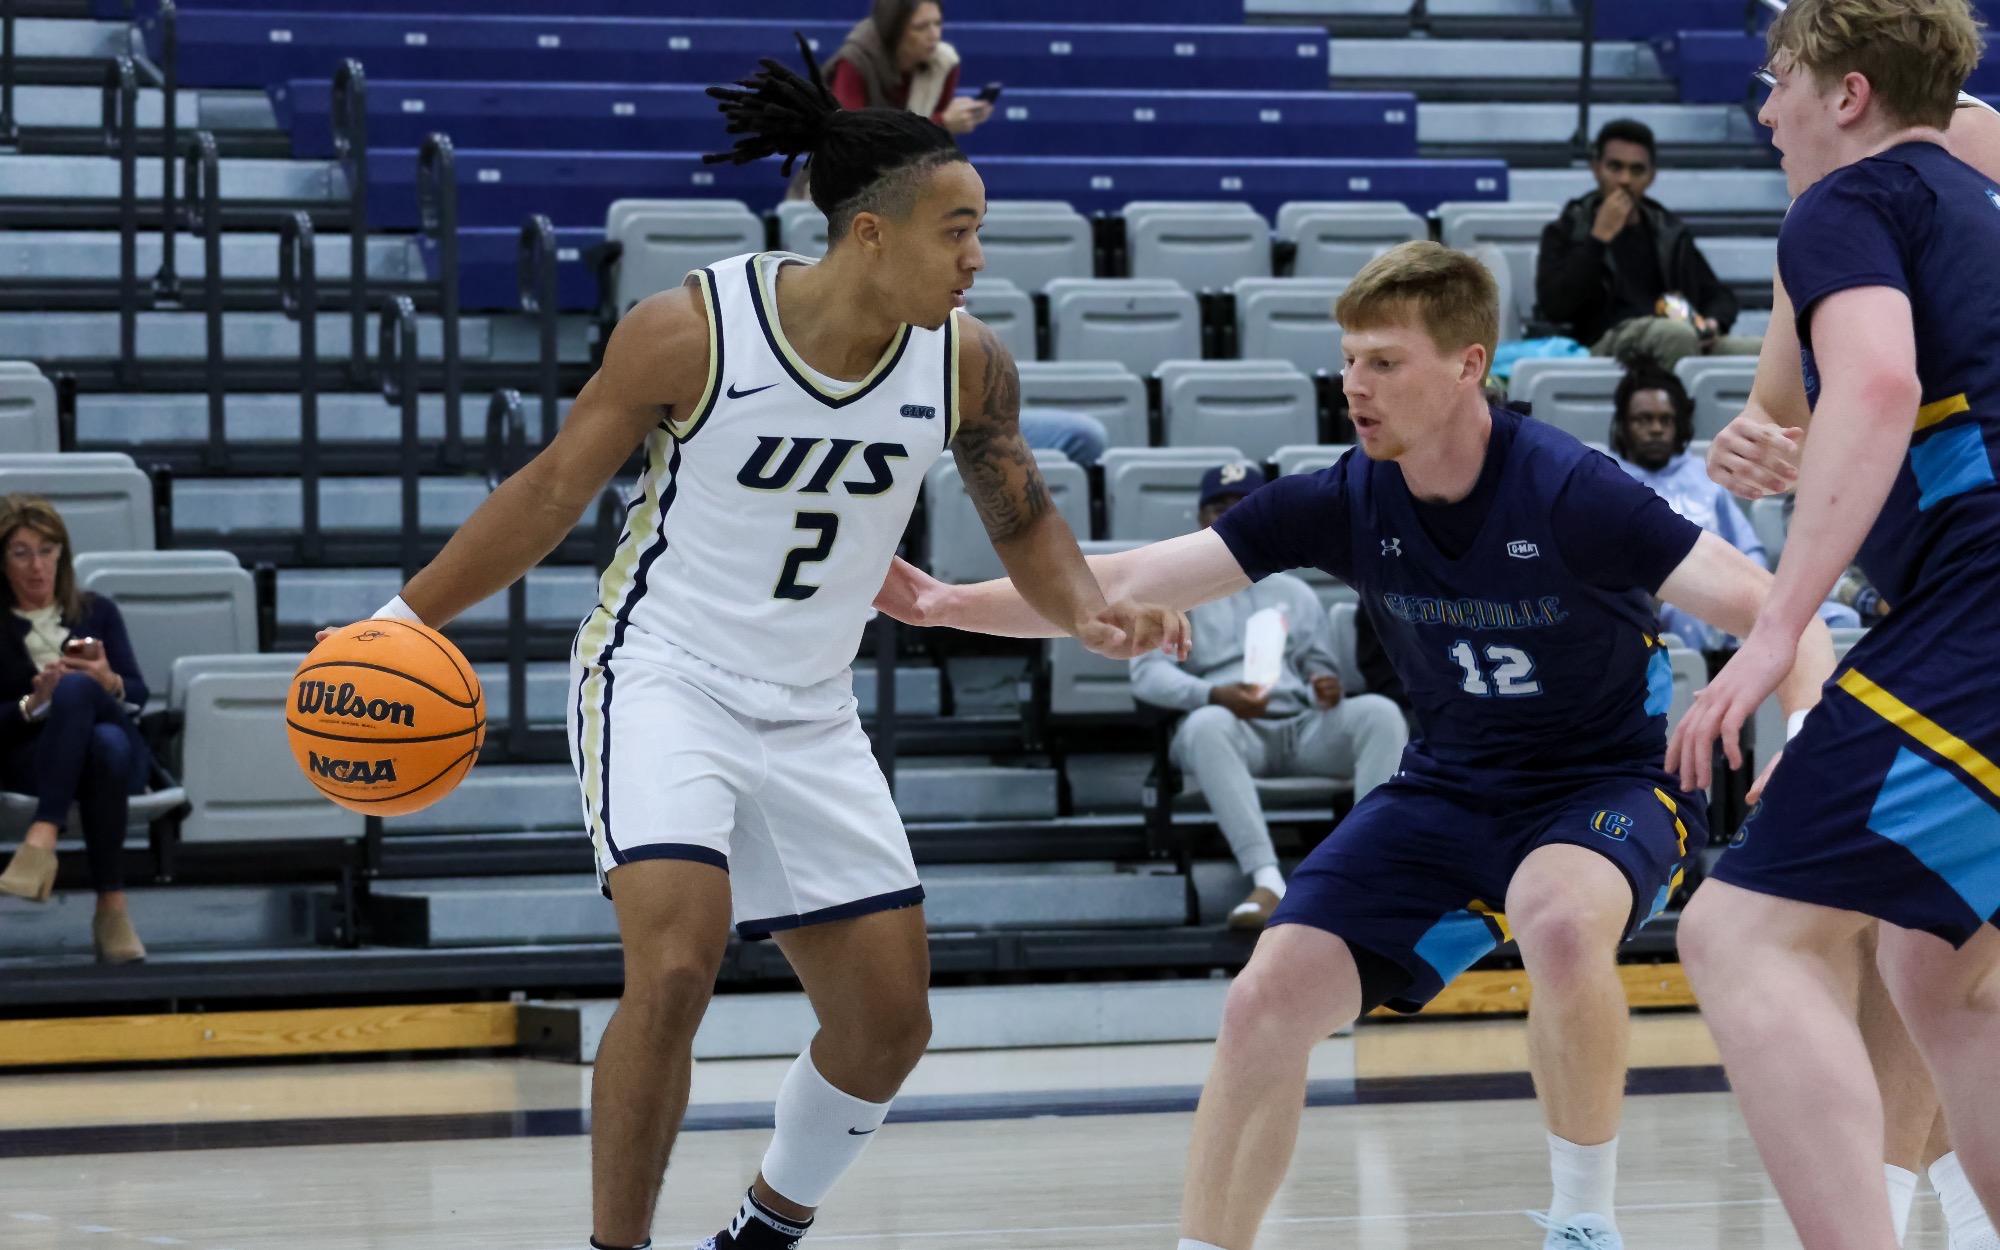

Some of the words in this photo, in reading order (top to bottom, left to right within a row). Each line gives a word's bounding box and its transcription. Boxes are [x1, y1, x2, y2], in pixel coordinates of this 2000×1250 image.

[736, 436, 909, 498] UIS
[770, 509, 841, 602] 2
[1448, 639, 1543, 697] 12
[297, 680, 415, 727] Wilson
[309, 750, 397, 784] NCAA
